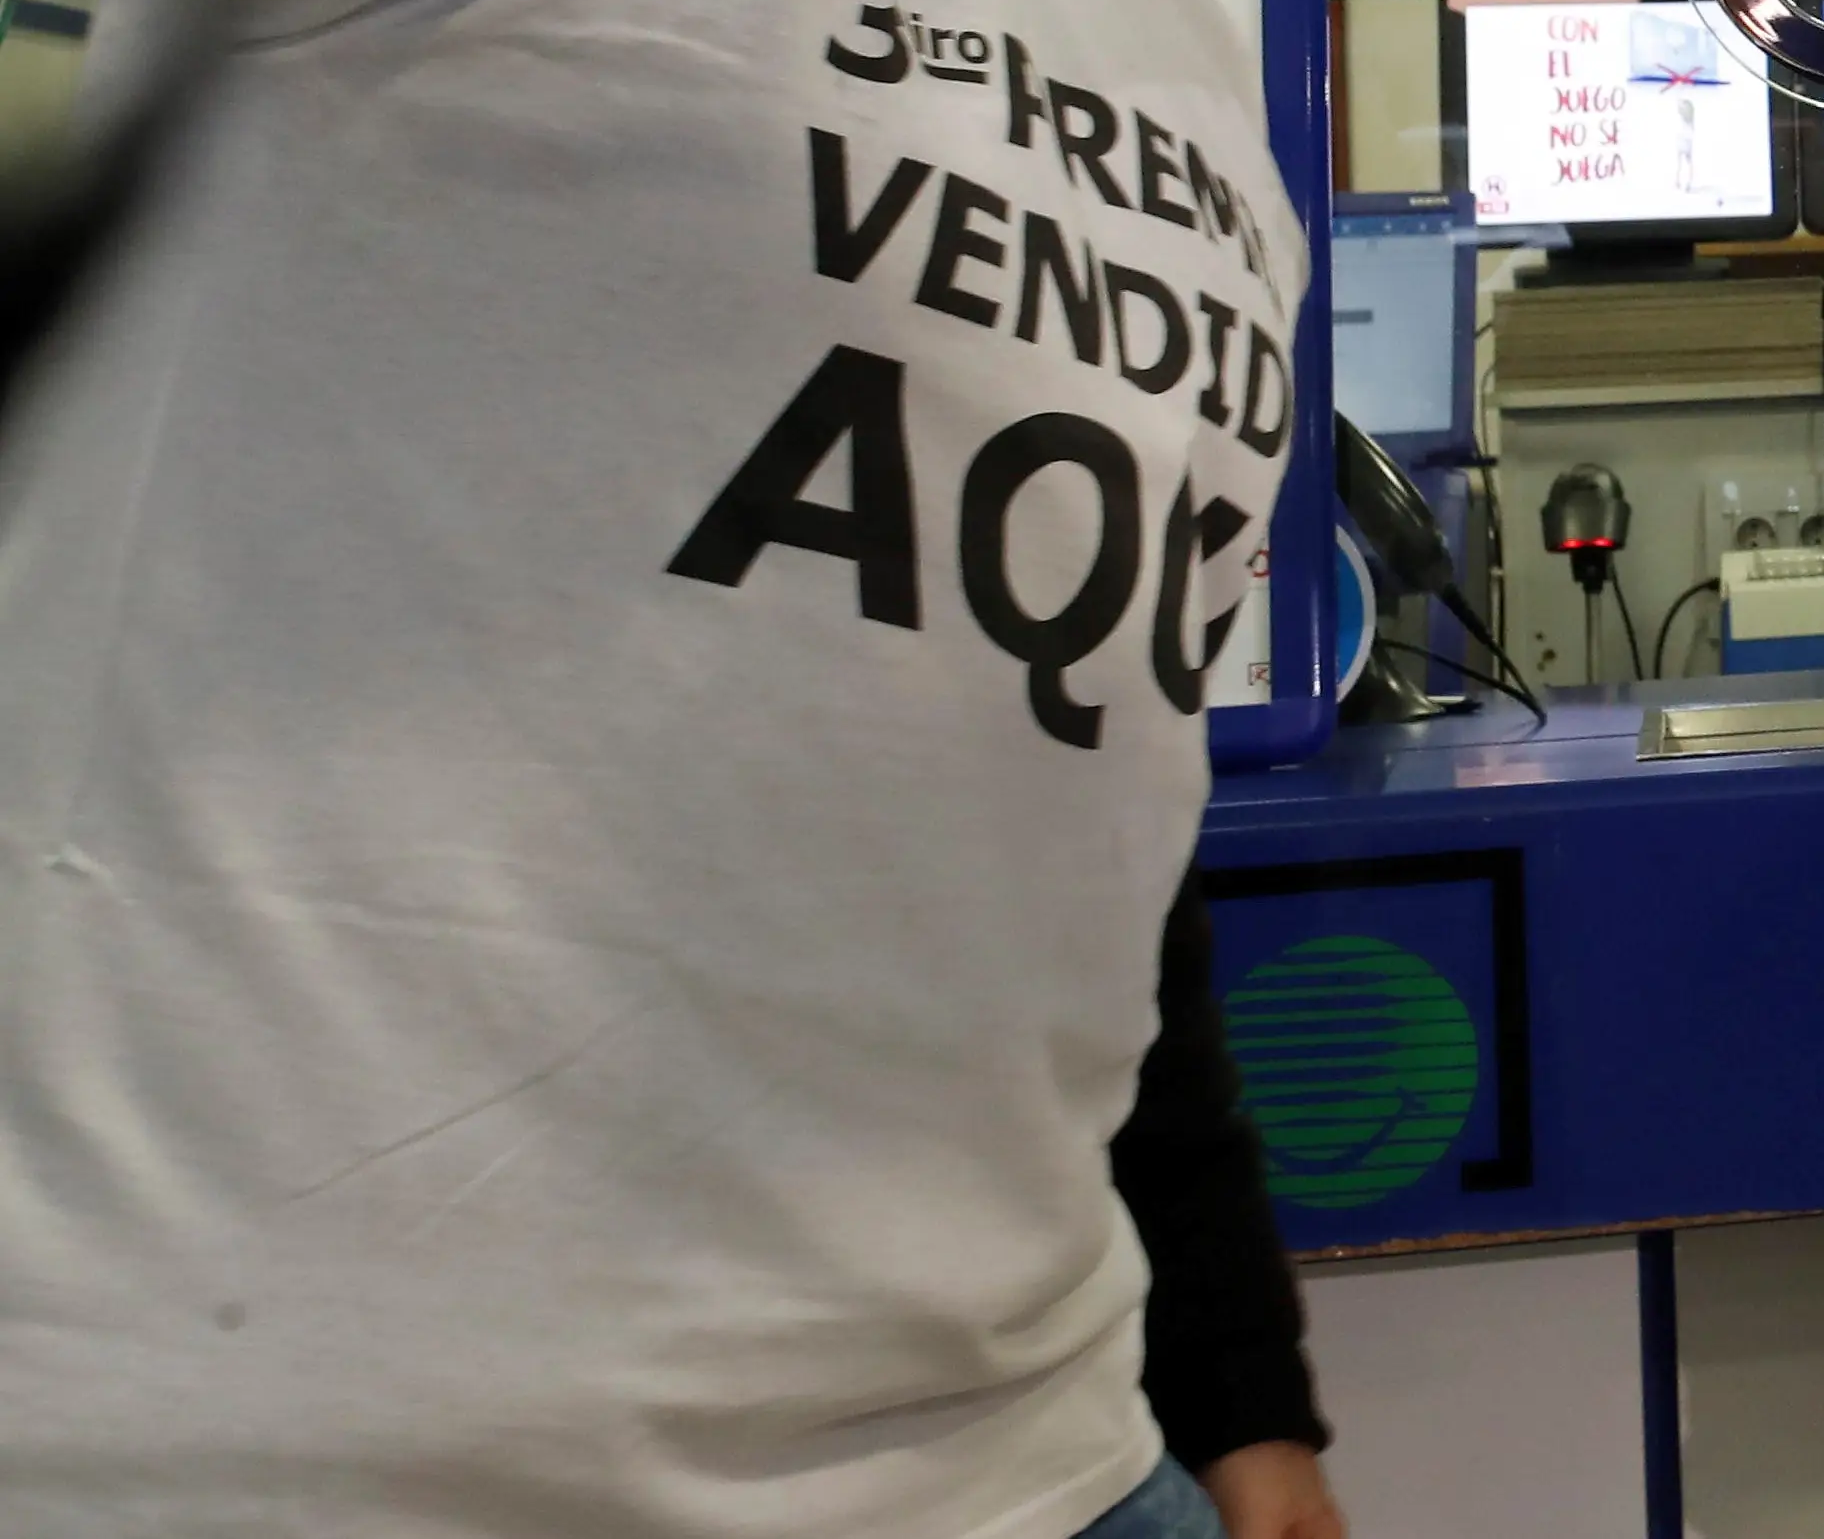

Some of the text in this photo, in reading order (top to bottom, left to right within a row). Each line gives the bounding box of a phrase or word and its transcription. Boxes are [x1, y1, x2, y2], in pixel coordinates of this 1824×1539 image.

[1548, 16, 1600, 44] CON
[1549, 49, 1571, 79] EL
[1550, 86, 1626, 115] JUEGO
[1550, 121, 1587, 150] NO
[1551, 153, 1626, 187] JUEGA
[808, 127, 1295, 459] VENDID
